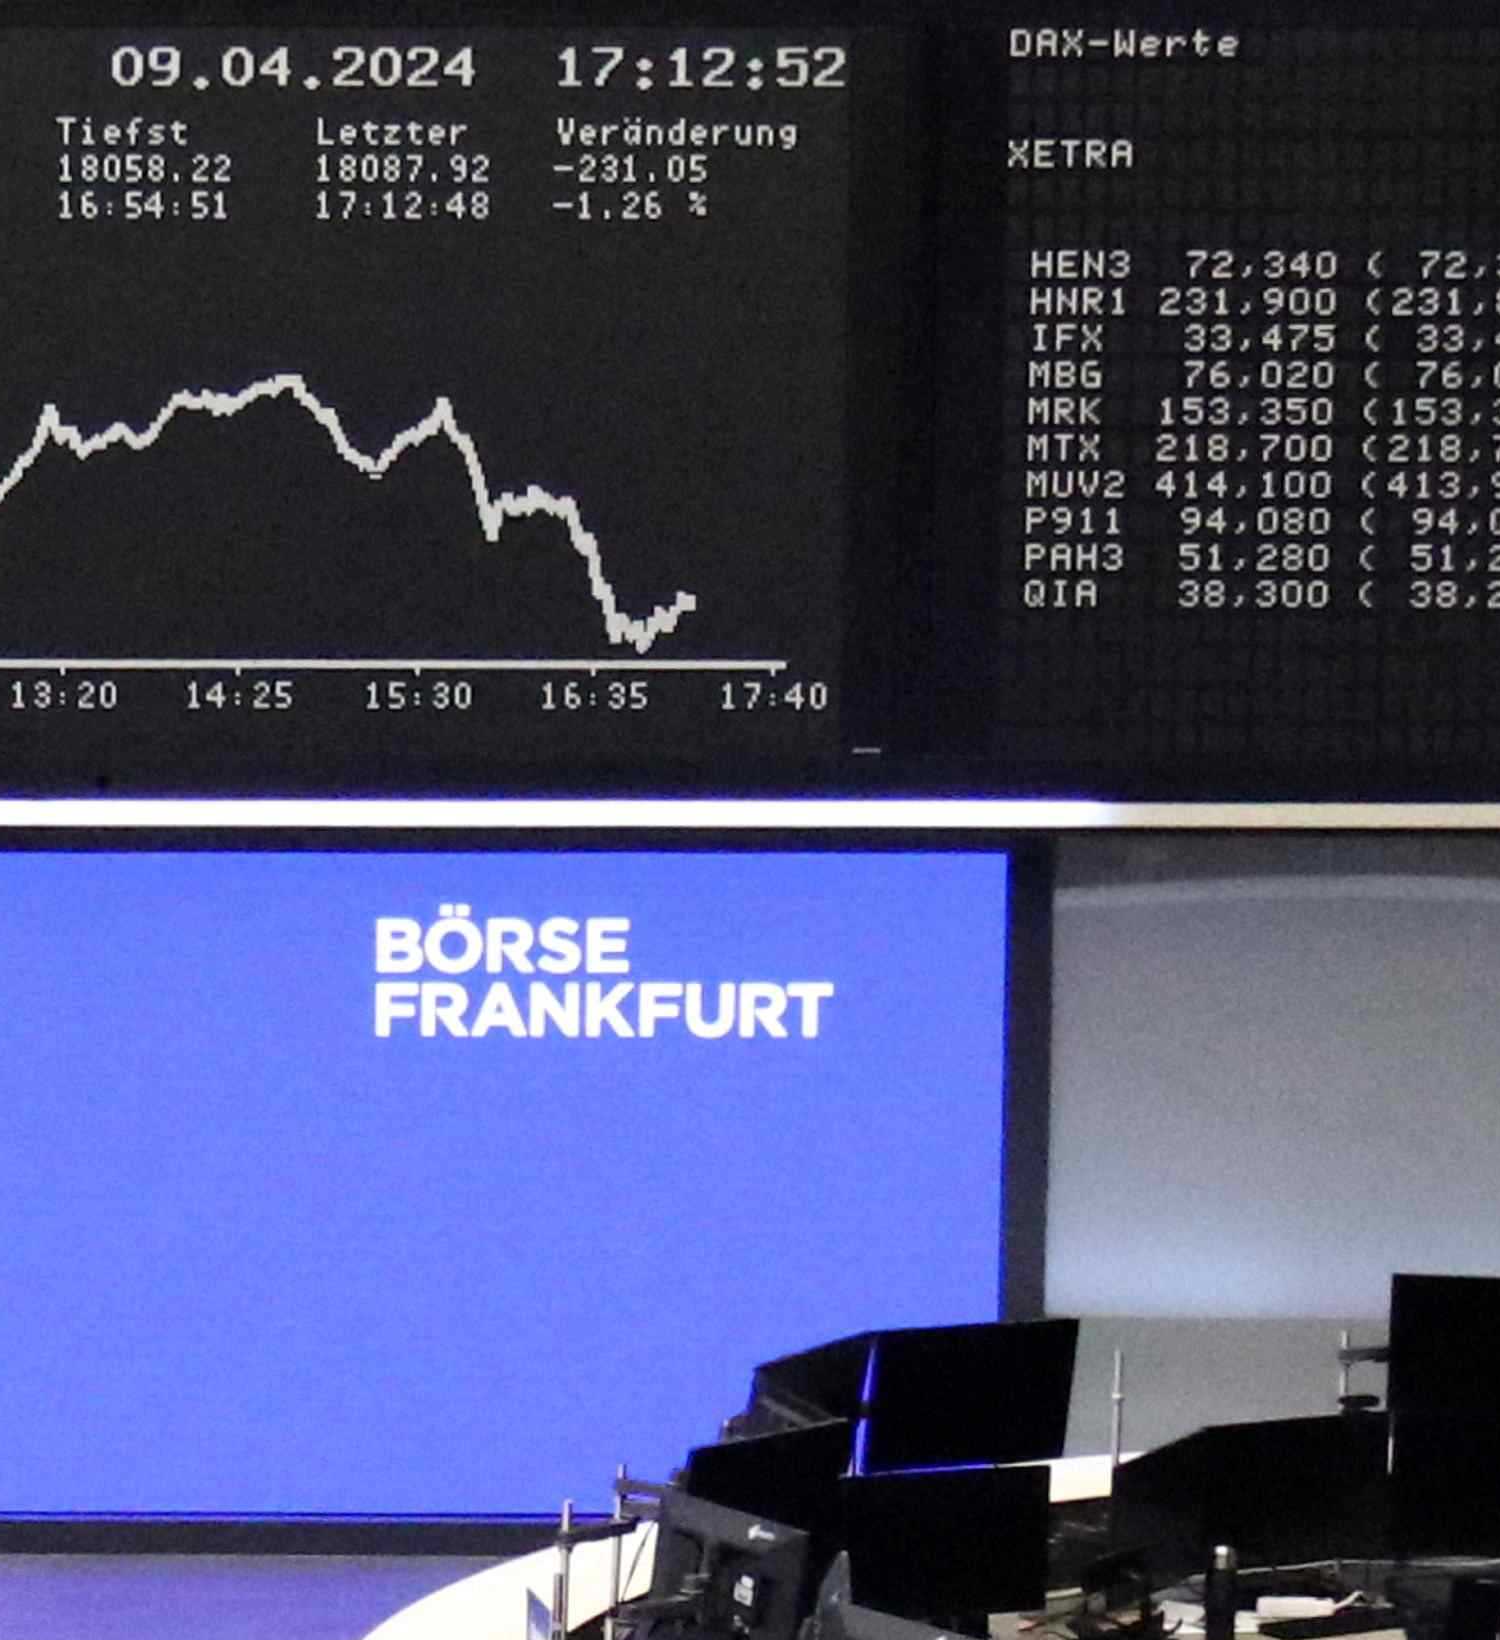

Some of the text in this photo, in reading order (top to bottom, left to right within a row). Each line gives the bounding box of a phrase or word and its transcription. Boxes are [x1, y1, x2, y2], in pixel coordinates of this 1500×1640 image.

[1009, 27, 1240, 59] DAX-Werte
[110, 44, 477, 91] 09.04.2024
[557, 45, 847, 92] 17:12:52
[54, 115, 188, 147] Tiefst
[316, 116, 469, 147] Letzter
[556, 116, 798, 151] Veränderung
[58, 152, 232, 184] 18058.22
[316, 152, 491, 184] 18087.92
[552, 152, 708, 184] -231.05
[1006, 137, 1134, 170] XETRA
[58, 189, 228, 221] 16:54:51
[315, 189, 490, 221] 17:12:48
[551, 189, 663, 221] -1.26
[687, 190, 708, 217] %
[1029, 248, 1338, 280] HEN3 72,340
[1029, 285, 1127, 317] HNR1
[1158, 285, 1338, 317] 231,900
[1032, 321, 1338, 354] IFX 33,475
[1027, 358, 1336, 390] MBG 76,020
[1026, 395, 1103, 426] MRK
[1159, 395, 1334, 427] 153,350
[1026, 432, 1102, 463] MTX
[1154, 432, 1334, 464] 218,700
[1025, 468, 1126, 500] MUV2
[1154, 469, 1333, 500] 414,100
[1024, 505, 1332, 536] P911 94,080
[1023, 541, 1331, 573] PAH3 51,280
[1022, 577, 1330, 610] QIA 38,300
[11, 679, 118, 710] 13:20
[186, 679, 294, 710] 14:25
[366, 680, 473, 711] 15:30
[541, 680, 649, 711] 16:35
[721, 681, 828, 711] 17:40
[374, 902, 631, 975] BÖRSE
[374, 981, 835, 1039] FRANKFURT
